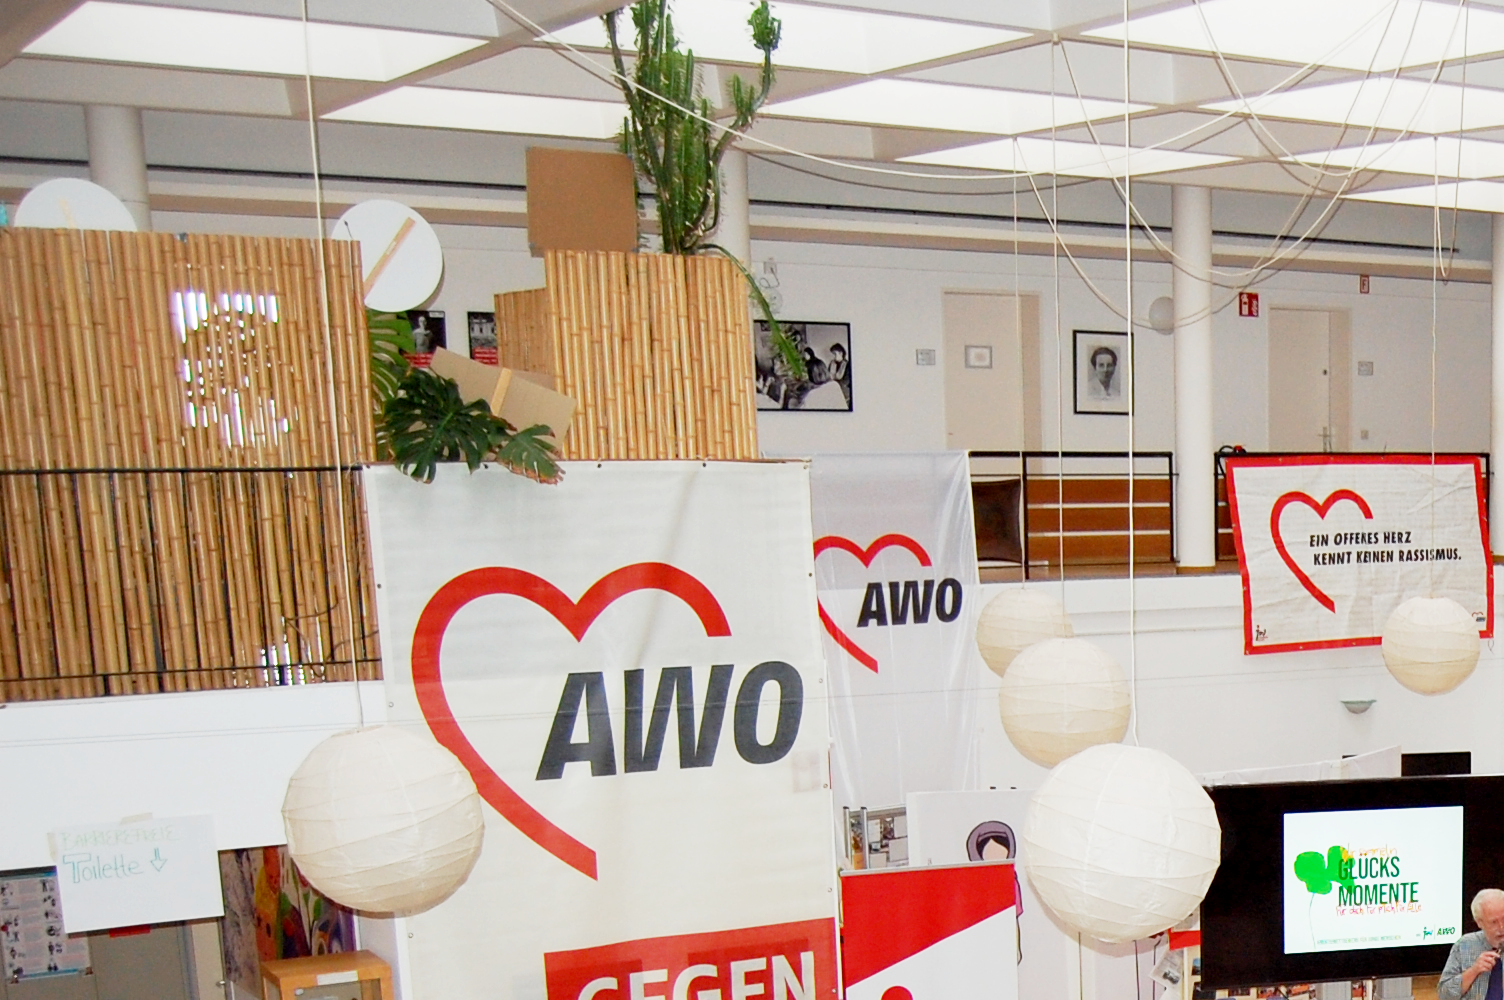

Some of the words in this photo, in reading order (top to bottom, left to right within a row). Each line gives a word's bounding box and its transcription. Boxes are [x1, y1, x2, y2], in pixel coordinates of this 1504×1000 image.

[1309, 533, 1329, 547] EIN
[1333, 531, 1379, 546] OFFENES
[1383, 531, 1412, 545] HERZ
[1313, 551, 1352, 566] KENNT
[1356, 549, 1394, 564] KEINEN
[1398, 547, 1462, 563] RASSISMUS.
[856, 577, 963, 628] AWO
[535, 660, 804, 781] AWO
[62, 853, 144, 884] Toilette
[1338, 852, 1400, 881] GLÜCKS
[1338, 881, 1419, 907] MOMENTE
[1437, 926, 1456, 937] AWO
